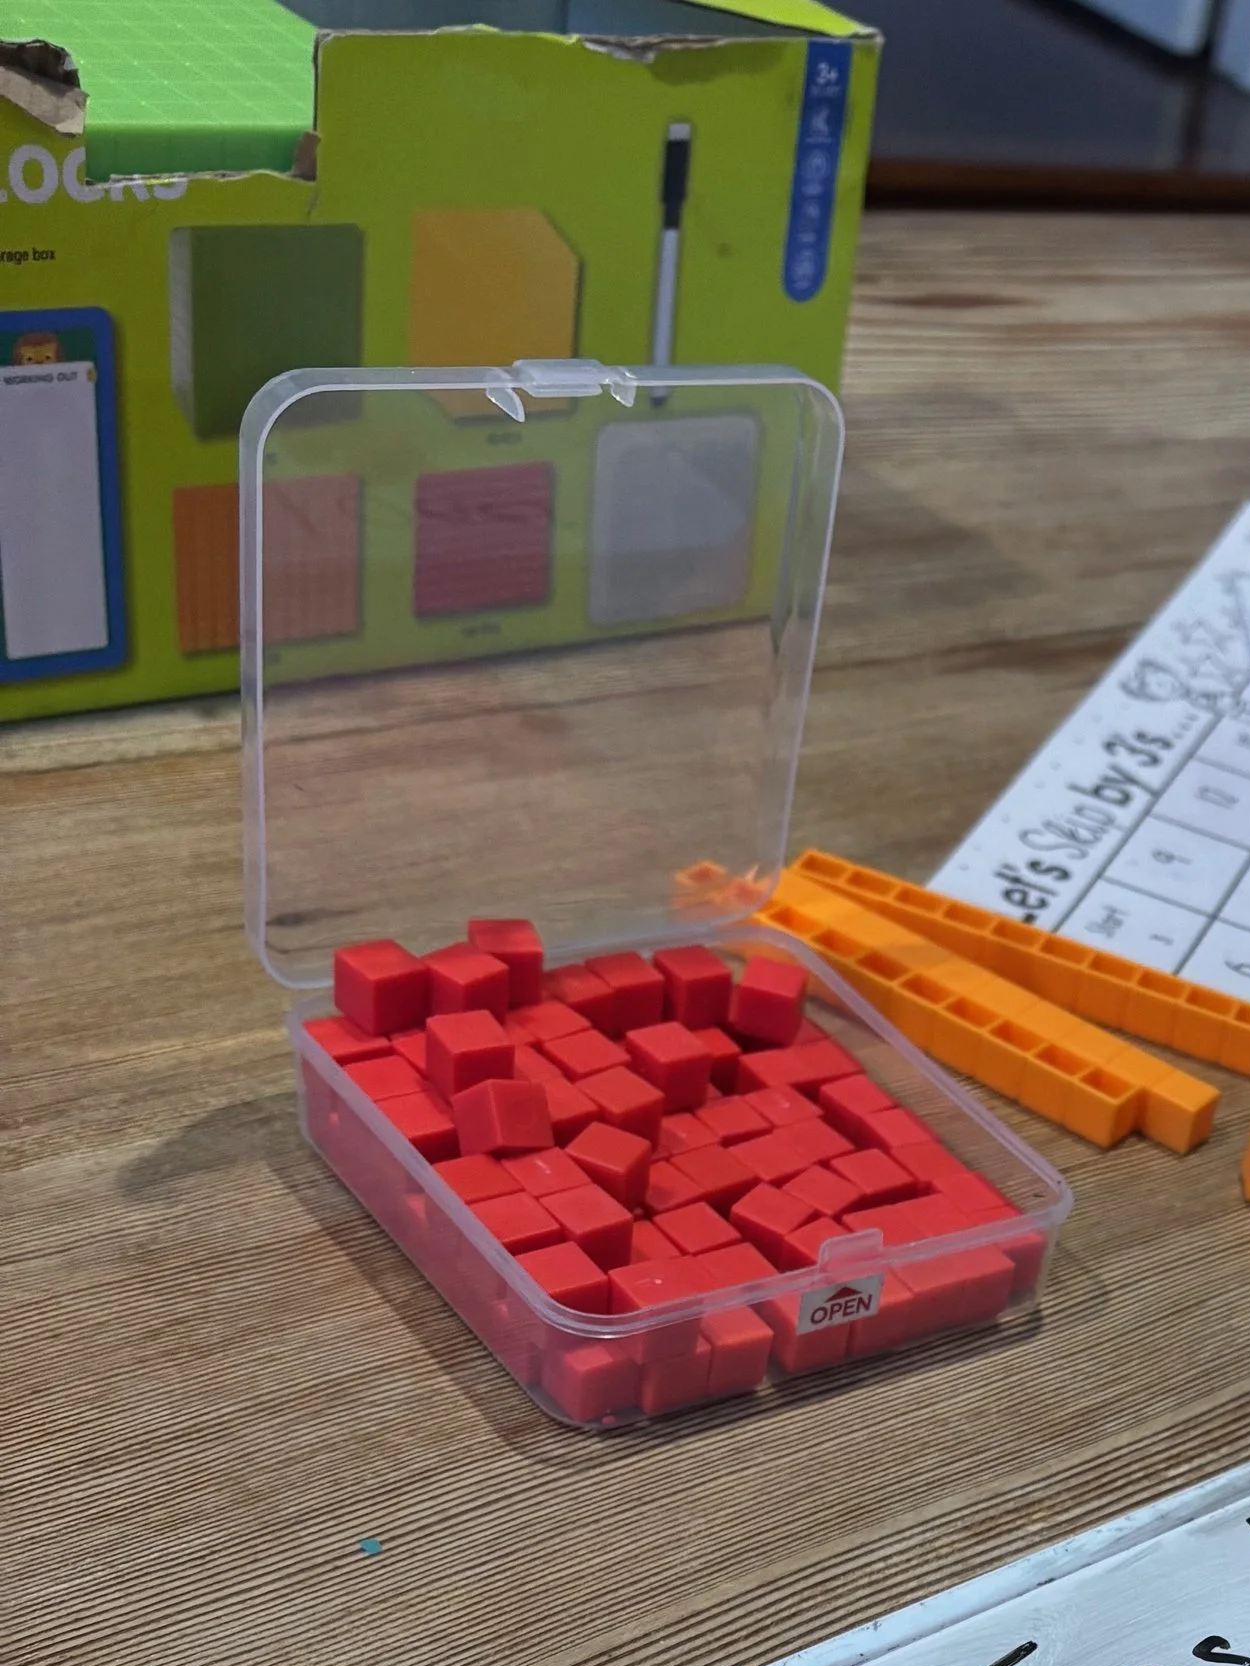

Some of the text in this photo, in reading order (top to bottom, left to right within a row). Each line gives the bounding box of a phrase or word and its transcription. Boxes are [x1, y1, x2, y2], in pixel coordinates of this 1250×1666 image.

[32, 248, 56, 262] box
[1065, 764, 1160, 807] by
[810, 1294, 873, 1325] OPEN
